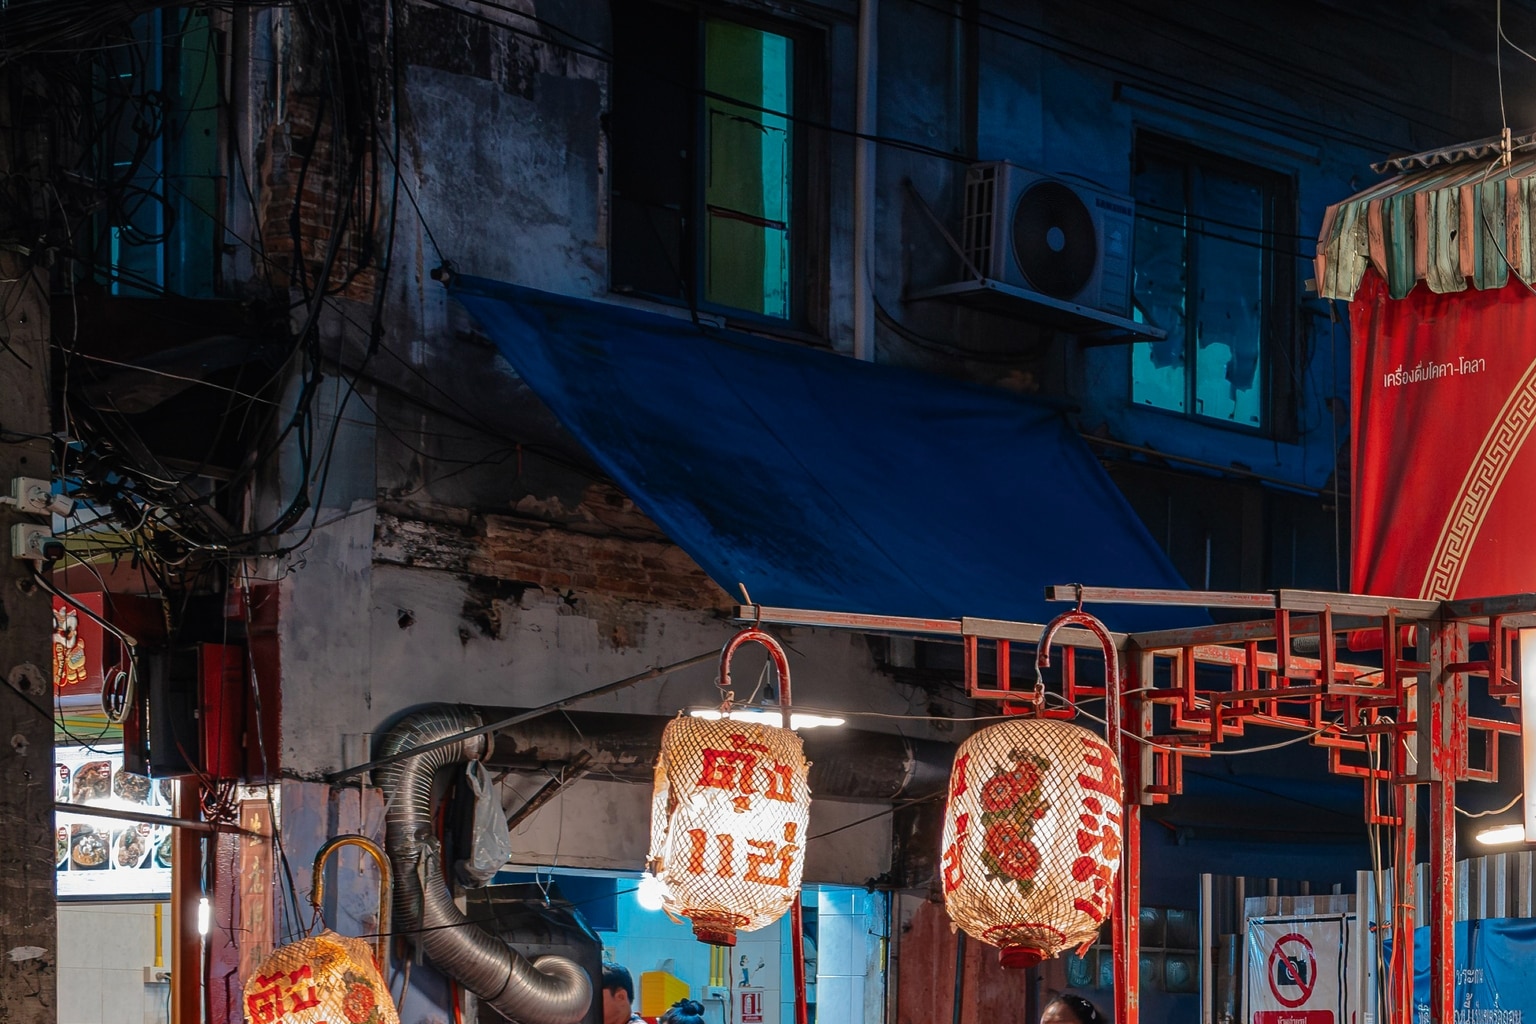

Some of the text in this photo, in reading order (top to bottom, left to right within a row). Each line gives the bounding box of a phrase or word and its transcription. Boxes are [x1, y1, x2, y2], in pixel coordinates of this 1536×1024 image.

[1383, 356, 1486, 388] เครื่องดื่มโคคา-โคลา
